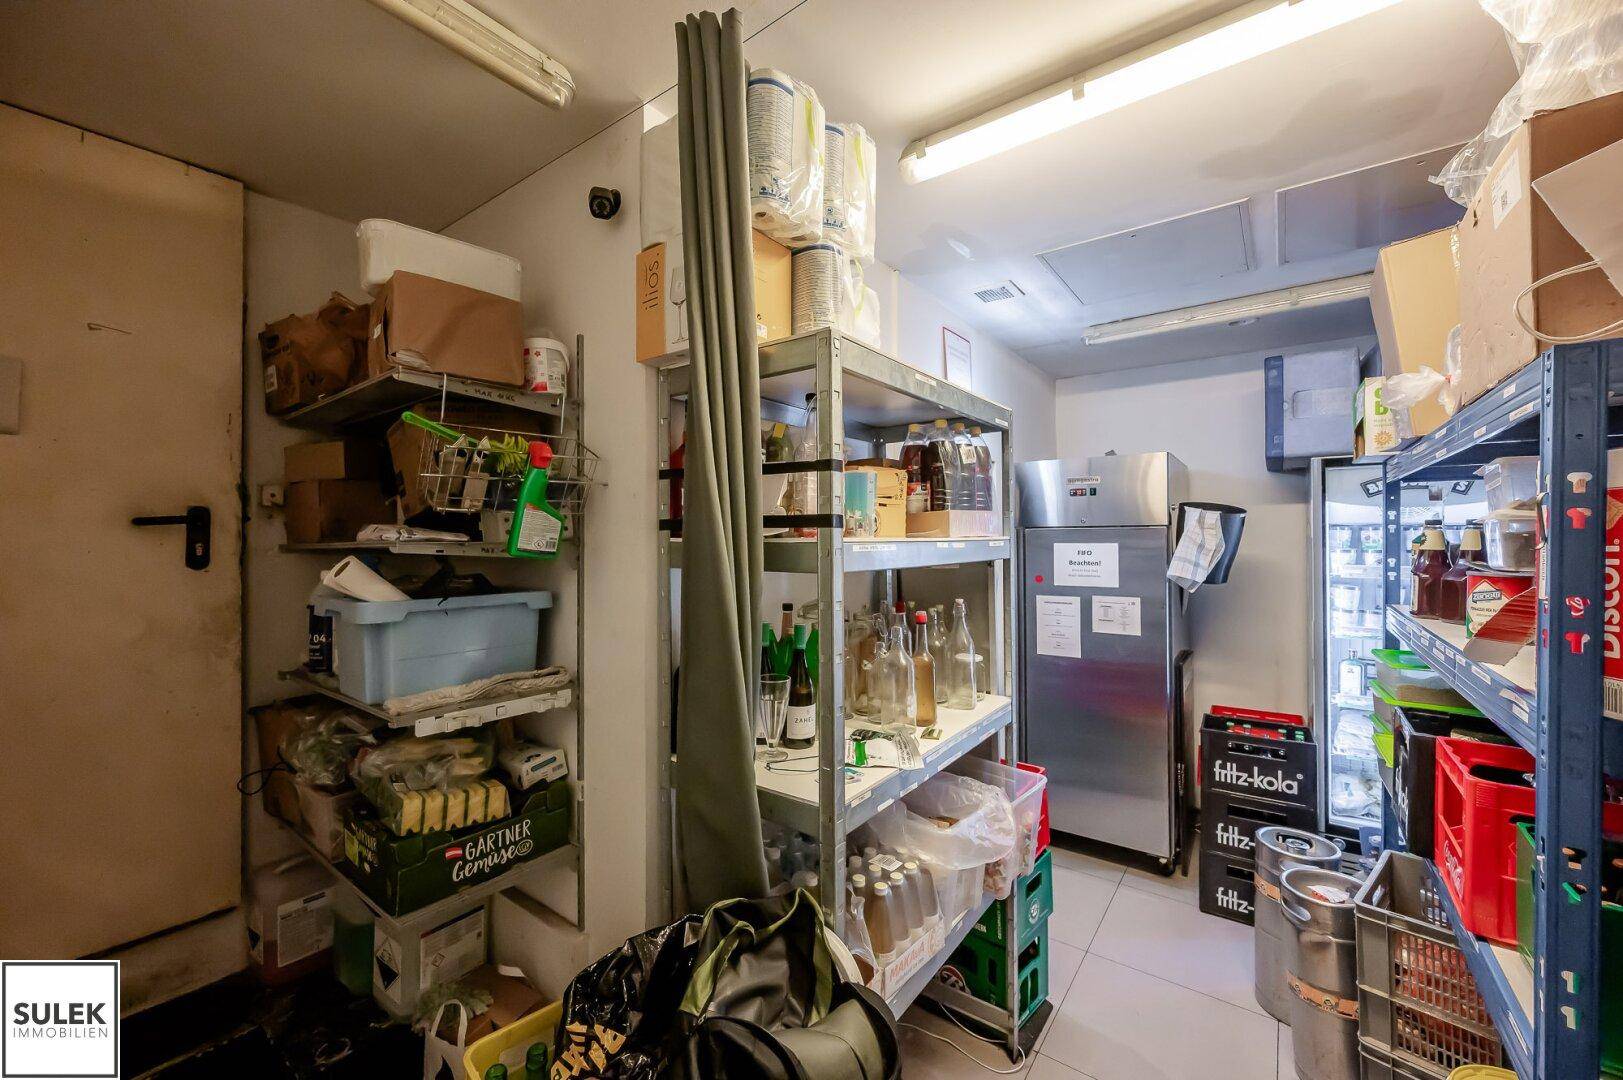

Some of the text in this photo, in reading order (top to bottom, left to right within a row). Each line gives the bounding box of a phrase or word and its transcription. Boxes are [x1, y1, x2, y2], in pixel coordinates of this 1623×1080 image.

[1068, 559, 1102, 567] Beachten!
[1213, 760, 1299, 796] fritz-kola
[1215, 822, 1256, 850] fritz-
[1215, 886, 1255, 914] fritz-
